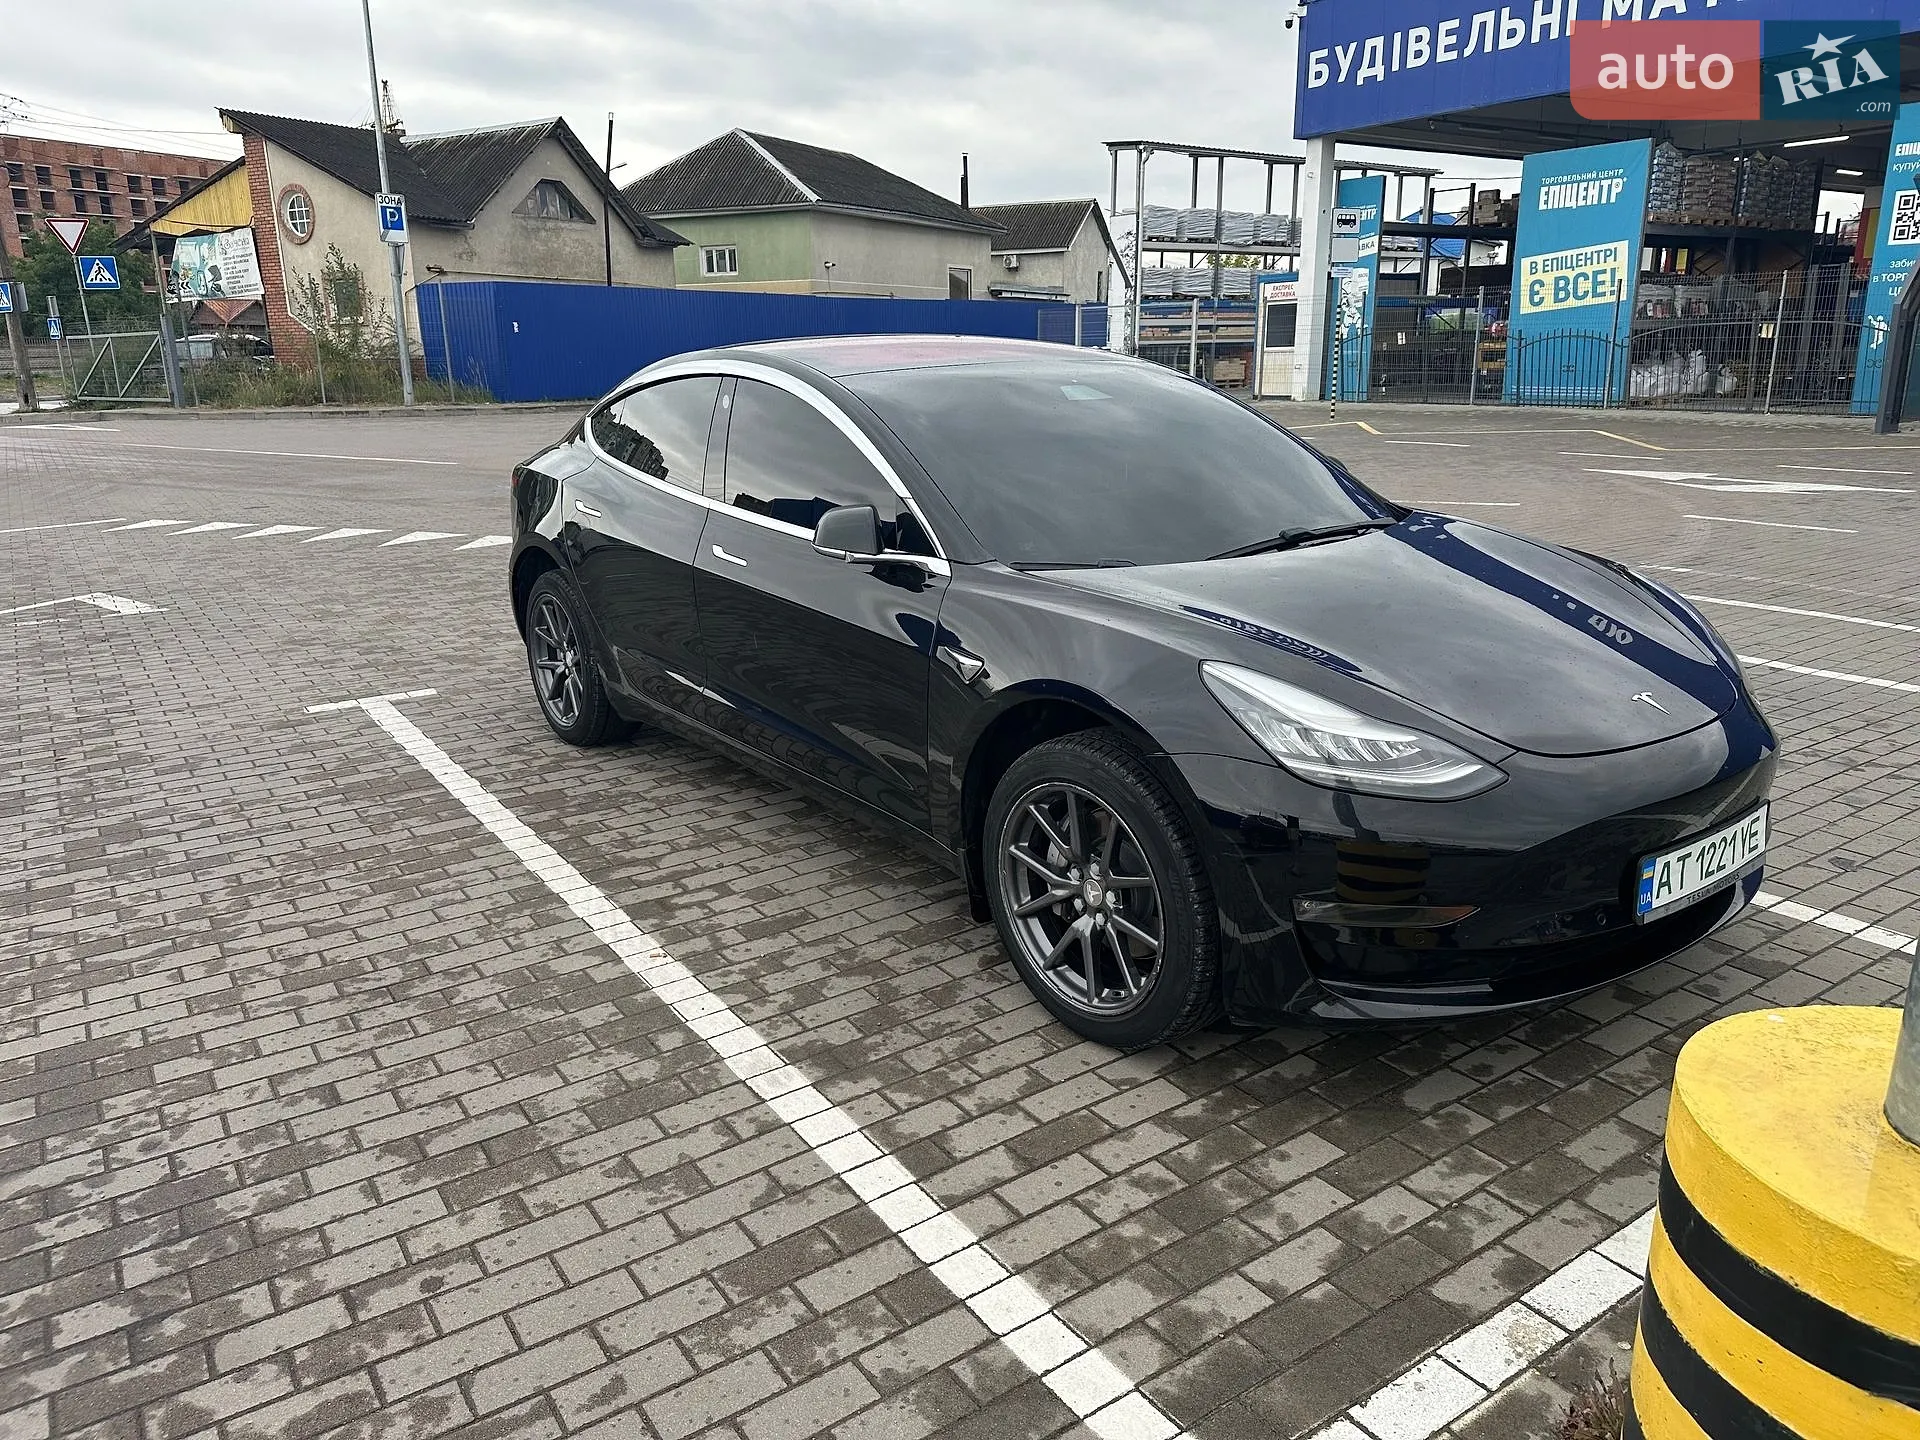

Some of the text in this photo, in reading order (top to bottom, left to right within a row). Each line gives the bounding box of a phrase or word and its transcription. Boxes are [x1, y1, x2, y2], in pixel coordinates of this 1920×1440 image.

[1307, 0, 1578, 89] БУДІВЕЛЬНІ
[1541, 168, 1624, 185] ТОРГОВЕЛЬНИЙ ЦЕНТР
[378, 195, 402, 206] ЗОНА
[1538, 177, 1625, 211] ЕПІЦЕНТР
[1529, 247, 1618, 276] В ЕПІЦЕНТРІ
[1890, 259, 1916, 269] заби
[1881, 272, 1908, 282] ТОРГ
[1272, 283, 1294, 292] ЕКСПРЕС
[1529, 267, 1617, 307] Є ВСЕ!
[1269, 290, 1296, 300] ДОСТАВКА
[1656, 815, 1760, 899] AT 1221 YE
[1640, 893, 1652, 905] UA
